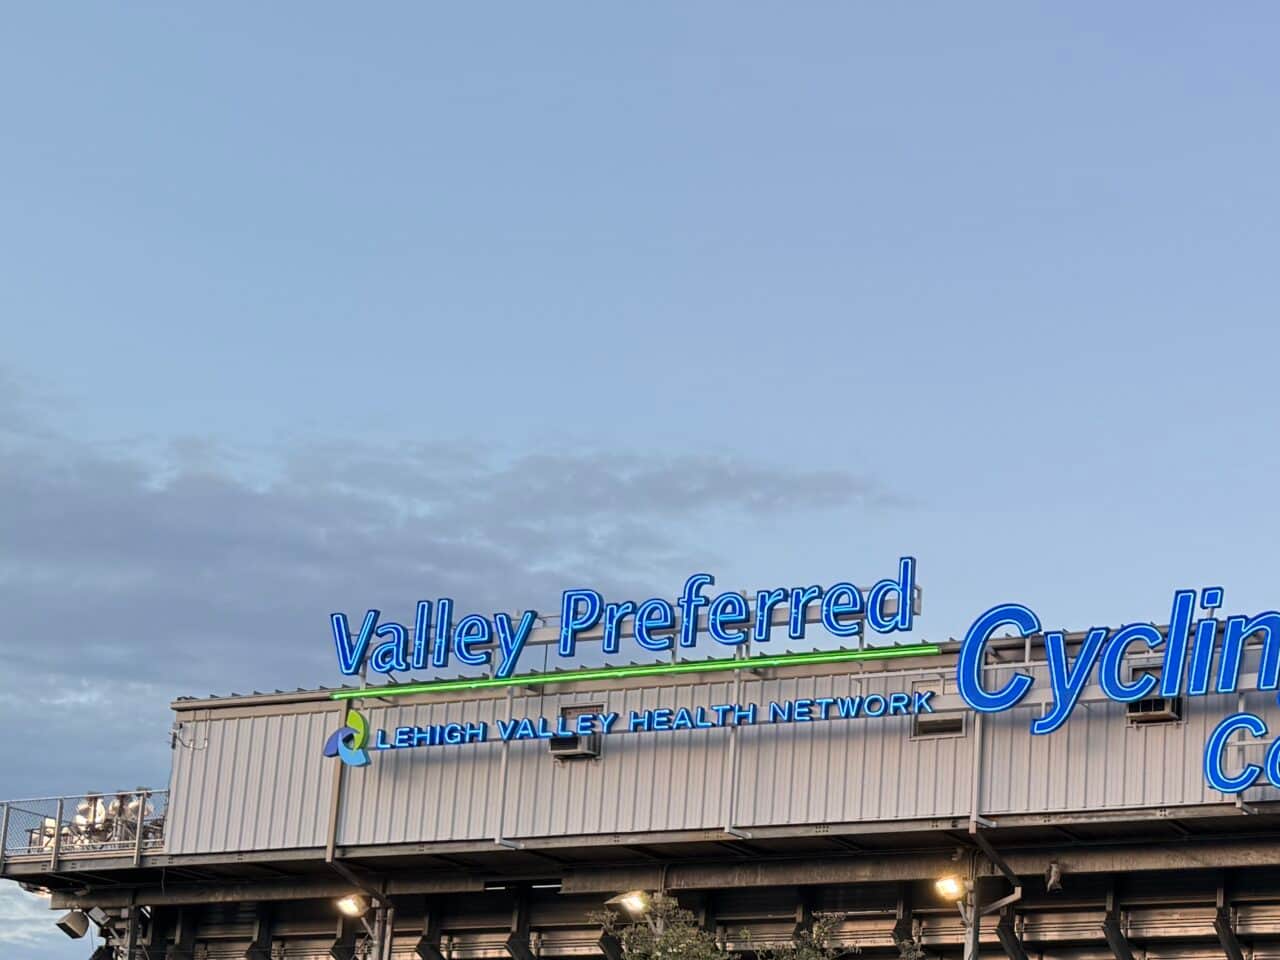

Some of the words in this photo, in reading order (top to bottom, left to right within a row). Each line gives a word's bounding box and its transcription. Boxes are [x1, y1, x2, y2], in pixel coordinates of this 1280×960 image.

[331, 598, 537, 678] Valley
[558, 556, 917, 658] Preferred
[376, 722, 487, 750] LEHIGH
[498, 712, 618, 741] VALLEY
[629, 703, 757, 731] HEALTH
[769, 691, 935, 723] NETWORK
